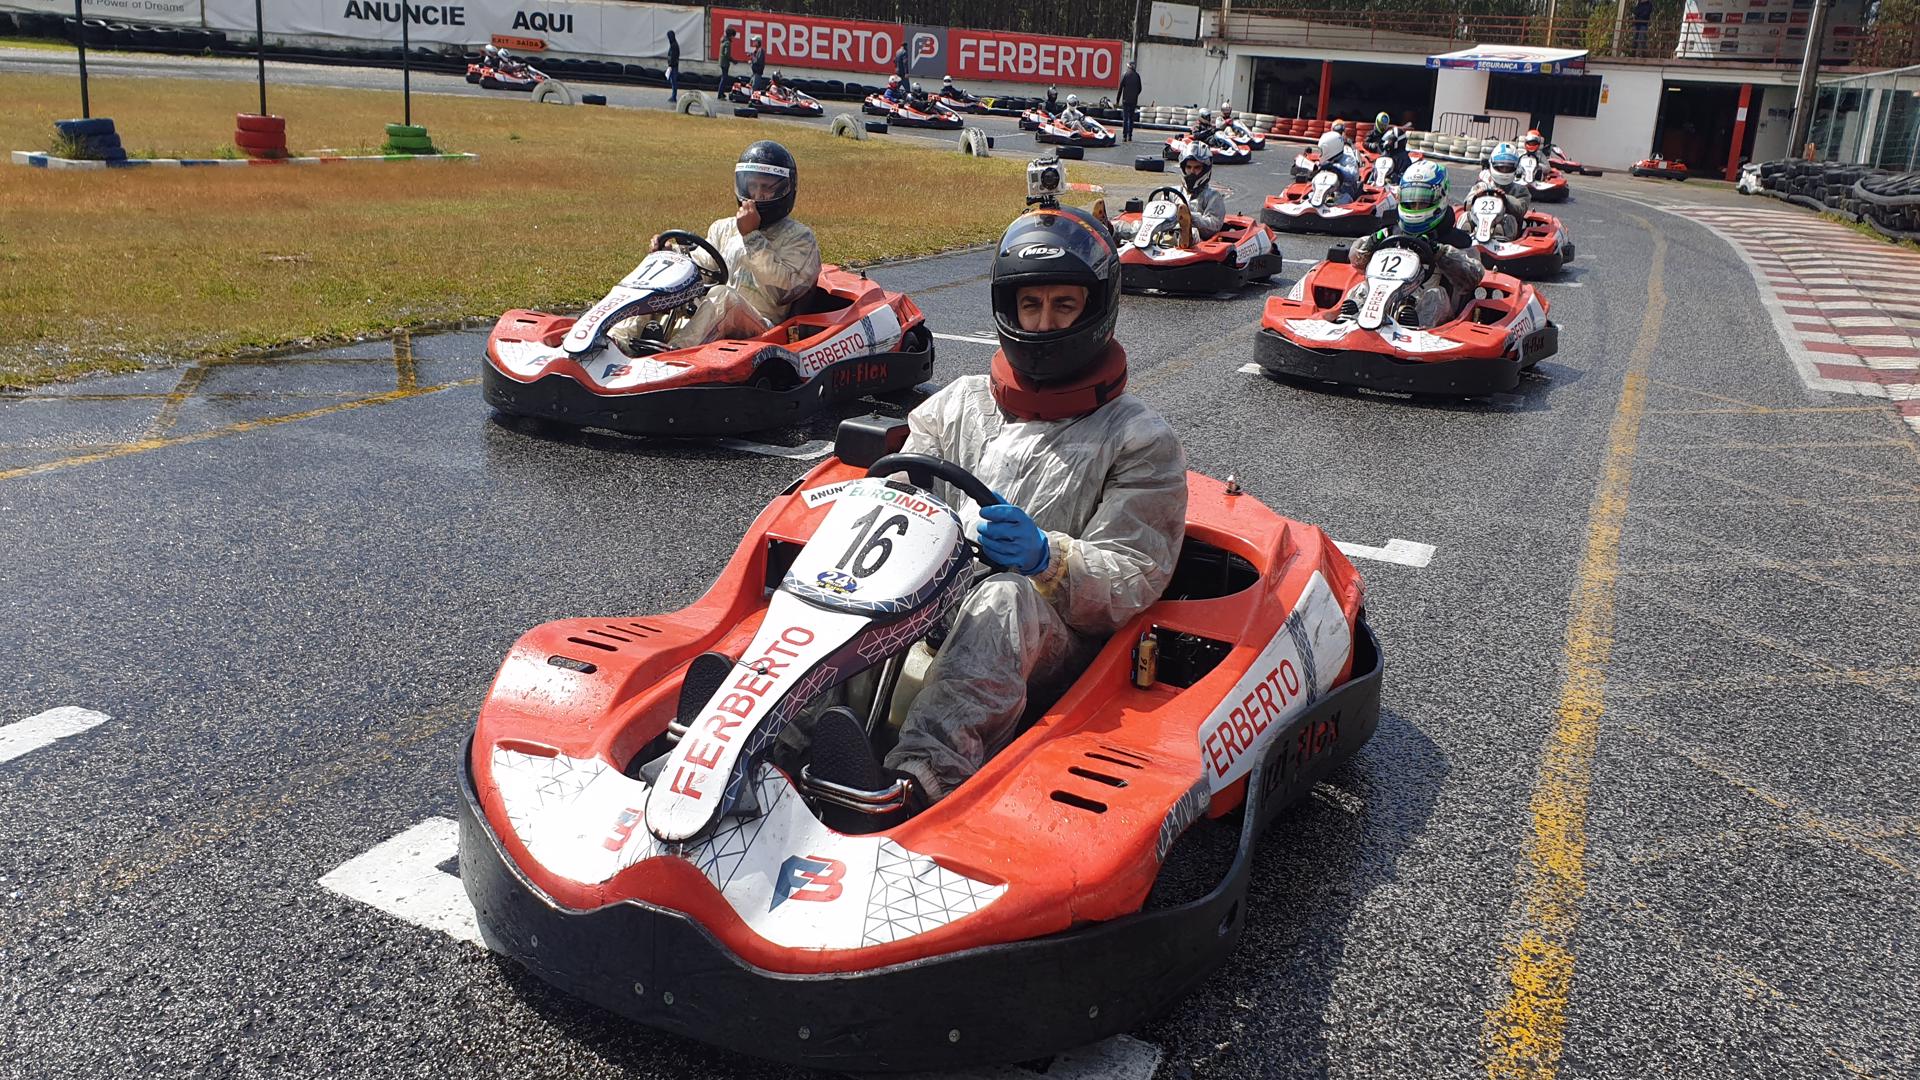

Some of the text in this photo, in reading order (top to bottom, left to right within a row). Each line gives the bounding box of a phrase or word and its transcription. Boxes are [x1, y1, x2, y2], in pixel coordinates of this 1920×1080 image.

[132, 1, 142, 10] of
[145, 1, 185, 12] Dreams
[344, 0, 574, 33] ANUNCIE AQUI
[723, 18, 893, 65] FERBERTO
[959, 38, 1112, 80] FERBERTO
[1477, 61, 1518, 71] SEGURANÇA
[1153, 204, 1166, 215] 18
[1481, 201, 1495, 211] 23
[1023, 247, 1061, 256] MDS
[1380, 256, 1402, 273] 12
[637, 259, 675, 281] 17
[801, 333, 866, 375] FERBERTO
[849, 486, 941, 518] EUROINDY
[836, 505, 909, 579] 16
[670, 627, 815, 800] FERBERTO
